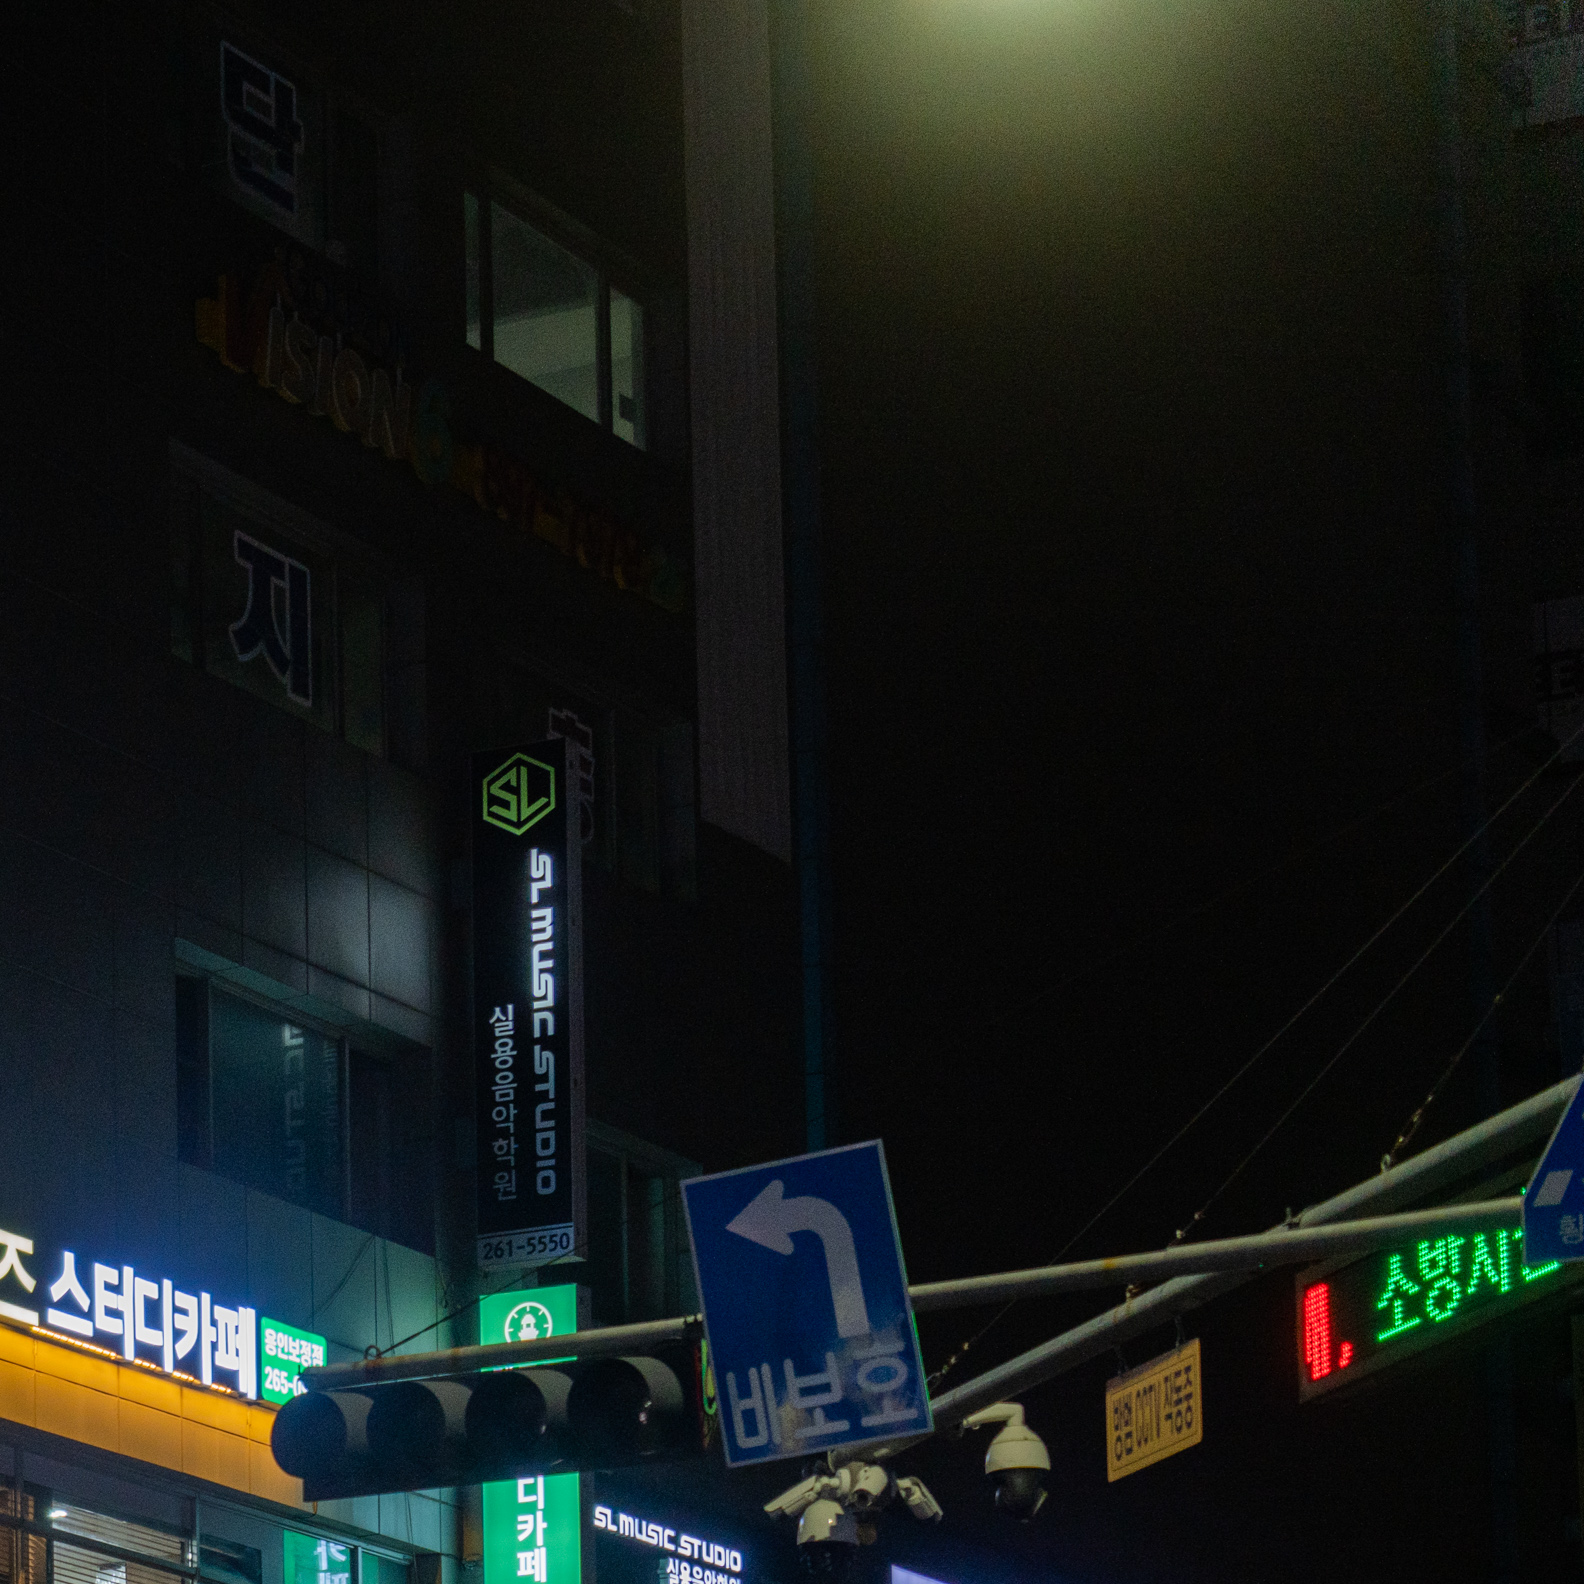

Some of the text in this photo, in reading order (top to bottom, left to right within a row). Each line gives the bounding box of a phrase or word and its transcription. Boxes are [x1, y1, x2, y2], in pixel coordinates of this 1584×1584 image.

[487, 1002, 520, 1203] 실용음악학원
[532, 1048, 558, 1197] STUDIO
[483, 1230, 571, 1262] 261-5550
[46, 1249, 257, 1401] 스터디카페
[724, 1312, 919, 1451] 비보호
[1135, 1380, 1162, 1449] CCTV
[515, 1474, 548, 1584] 디카페
[677, 1533, 744, 1573] STUDIO
